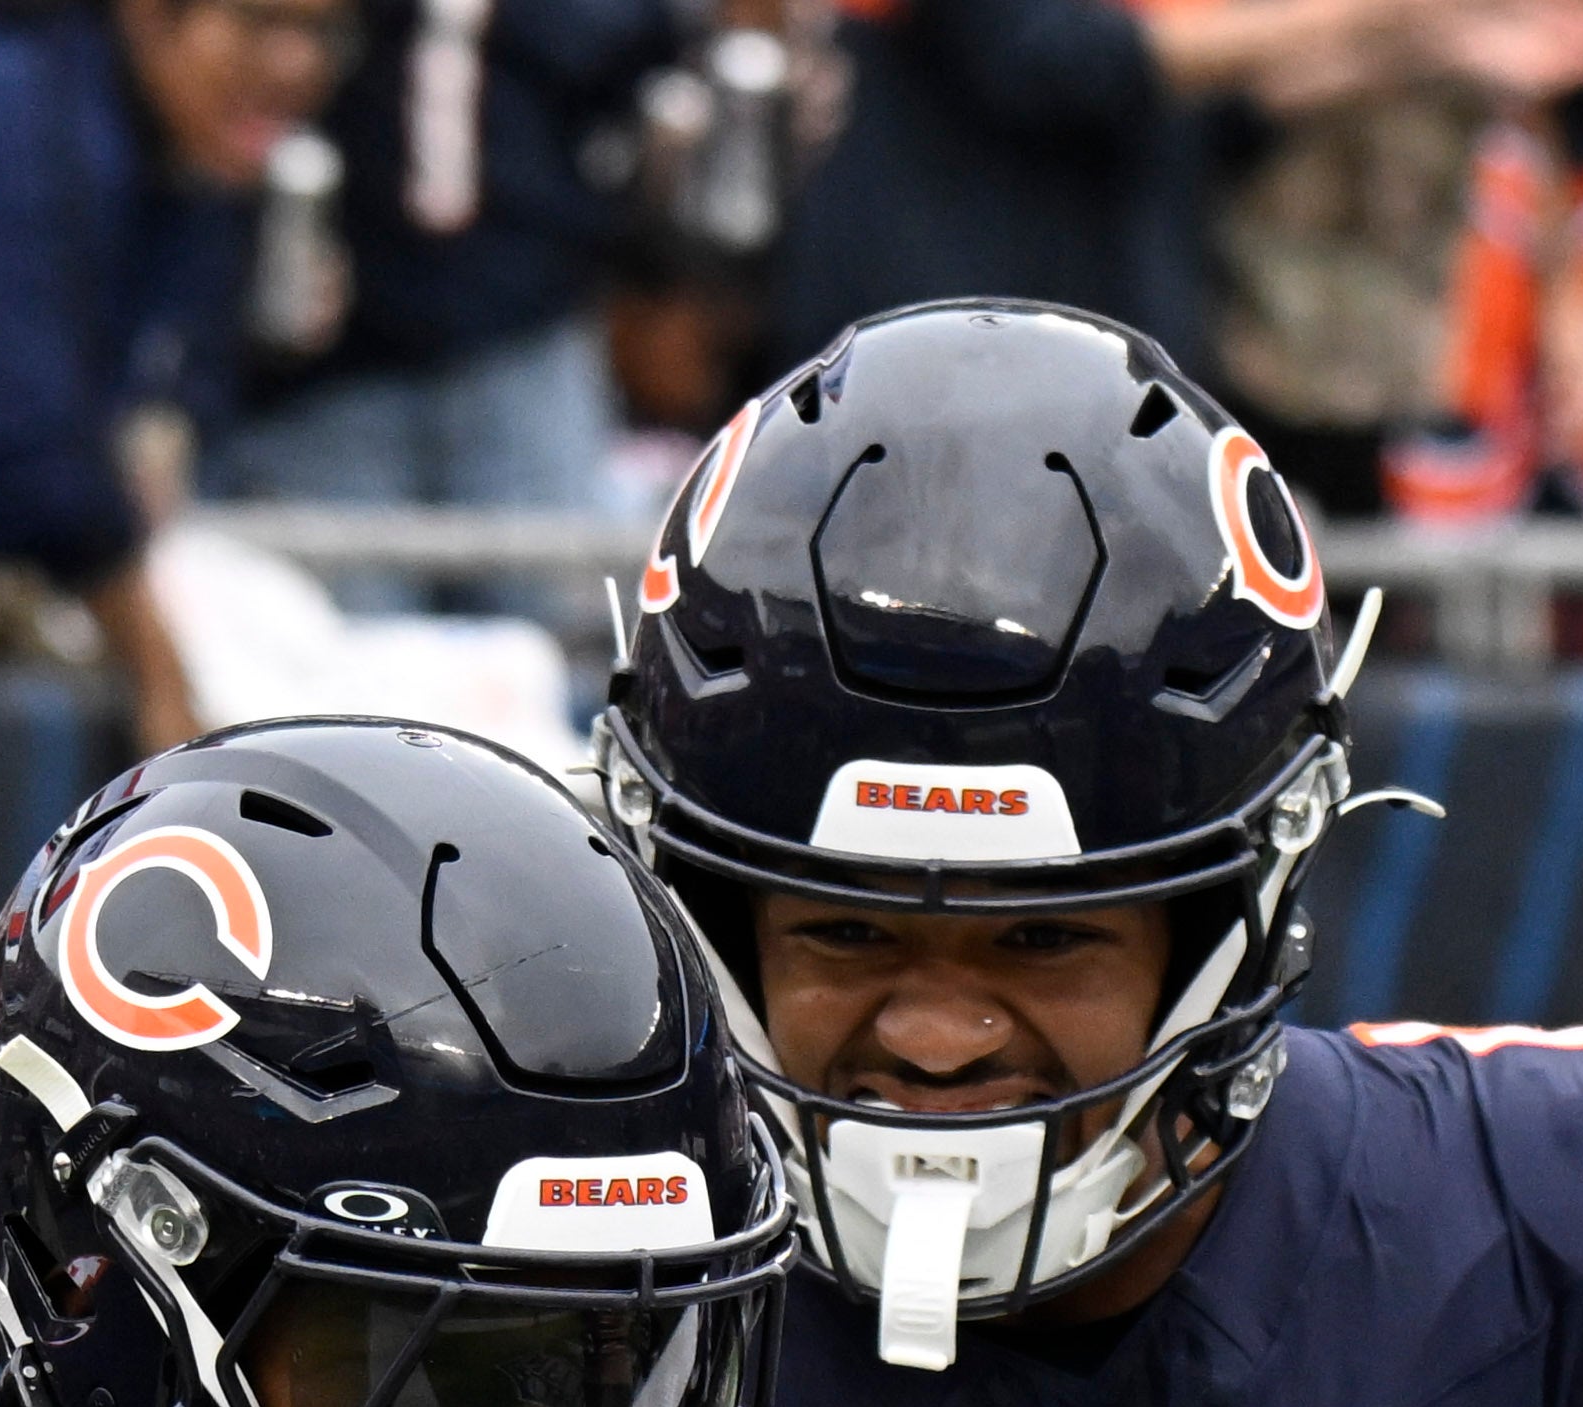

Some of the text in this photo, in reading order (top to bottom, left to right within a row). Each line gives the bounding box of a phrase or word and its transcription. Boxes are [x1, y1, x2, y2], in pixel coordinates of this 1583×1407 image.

[856, 781, 1029, 816] BEARS
[59, 826, 273, 1051] C
[540, 1176, 688, 1206] BEARS
